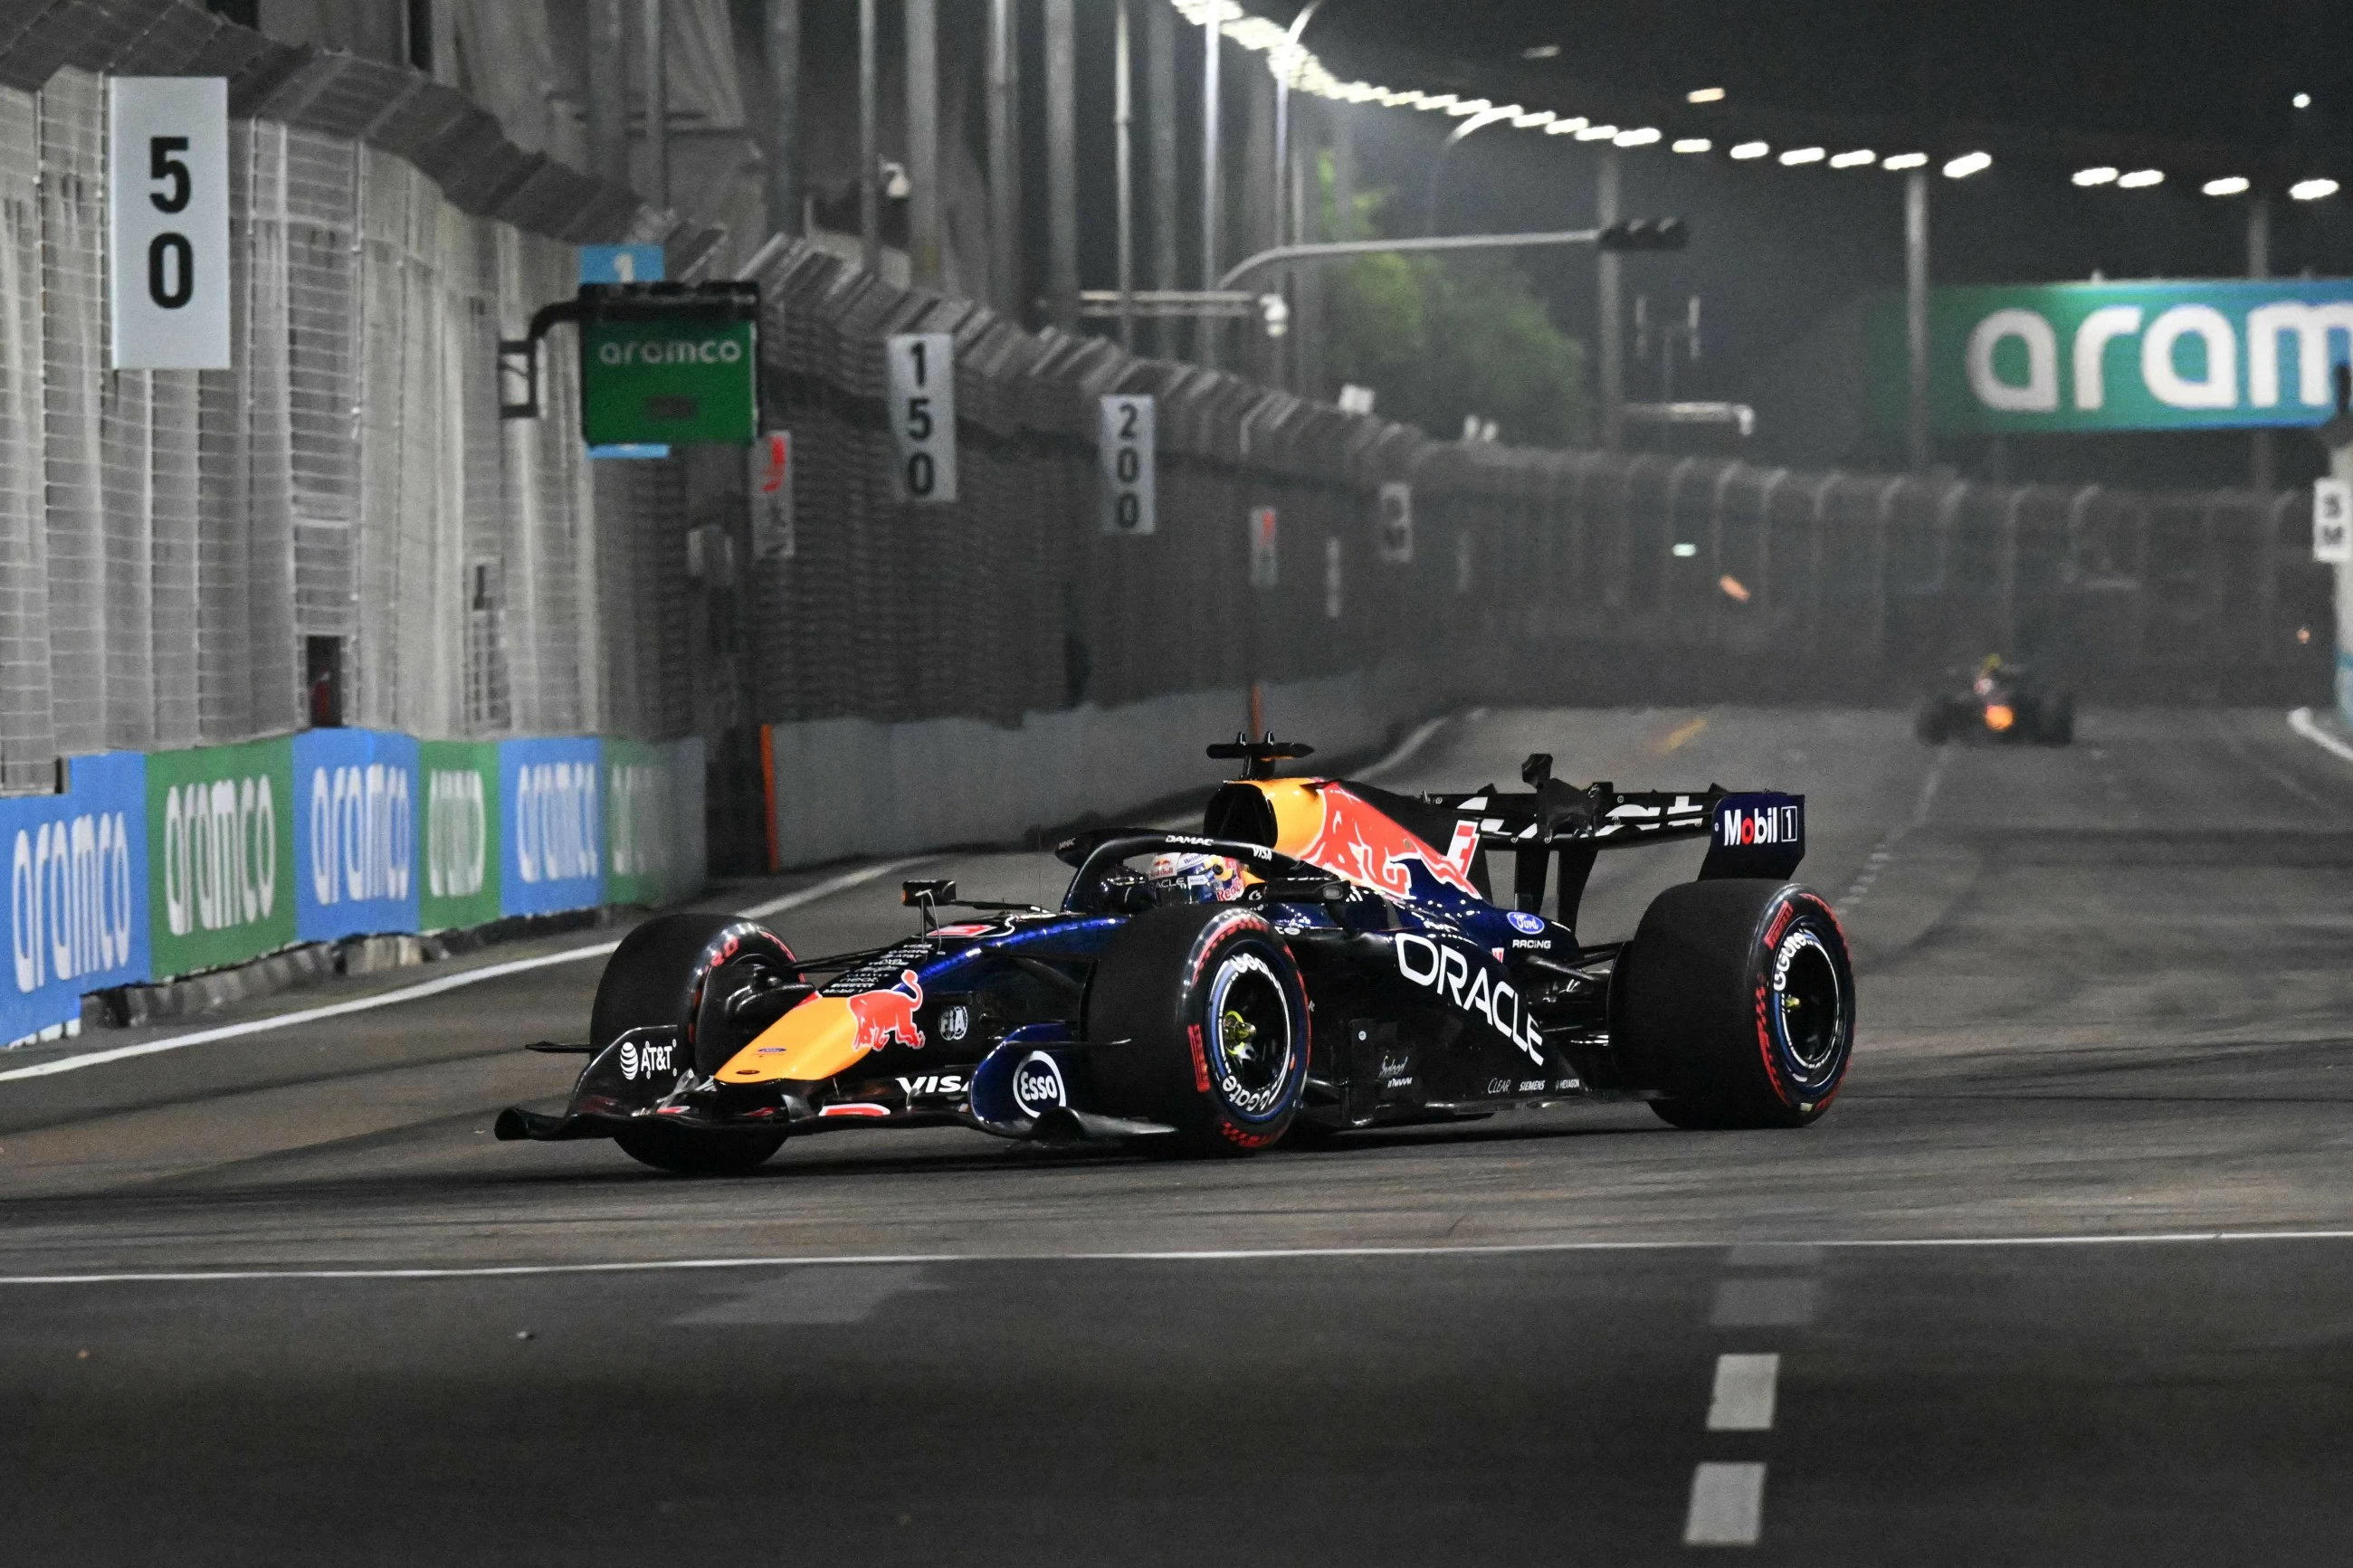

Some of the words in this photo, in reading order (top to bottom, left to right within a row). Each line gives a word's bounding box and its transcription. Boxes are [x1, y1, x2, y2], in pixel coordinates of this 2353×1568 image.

[148, 136, 194, 309] 50
[598, 338, 742, 365] aramco
[908, 342, 935, 497] 150
[1116, 403, 1140, 527] 200
[1165, 834, 1215, 847] DAMAC
[1724, 806, 1777, 846] Mobil
[1784, 806, 1796, 841] 1
[165, 774, 276, 936] aramco
[1253, 846, 1272, 861] VISA
[12, 811, 131, 993] aramco
[1514, 914, 1539, 930] Ford
[1395, 932, 1545, 1067] ORACLE
[641, 1045, 672, 1072] AT&T
[1519, 1079, 1546, 1091] SIEMENS
[1559, 1079, 1580, 1089] HEXAGON
